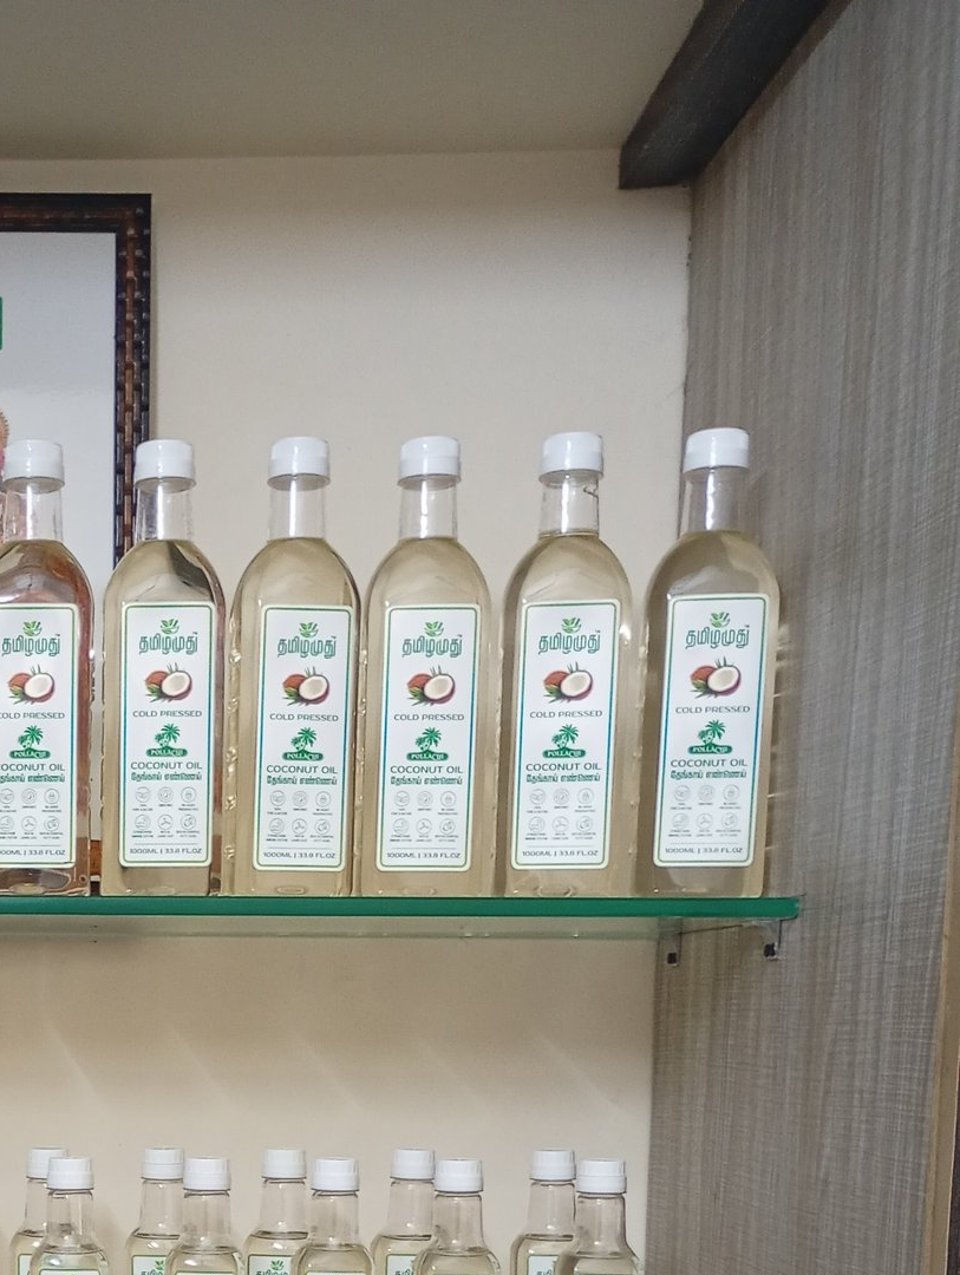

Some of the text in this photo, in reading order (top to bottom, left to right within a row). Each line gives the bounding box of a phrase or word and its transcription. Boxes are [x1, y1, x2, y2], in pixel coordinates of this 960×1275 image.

[558, 710, 603, 718] PRESSED
[675, 705, 750, 714] COLD PRESSED
[269, 713, 339, 722] COLD PRESSED
[48, 763, 65, 771] OIL
[130, 761, 202, 769] COCONUT OIL
[525, 762, 601, 771] COCONUT OIL
[670, 758, 748, 767] COCONUT OIL
[266, 764, 338, 774] COCONUT OIL
[390, 765, 463, 773] COCONUT OIL
